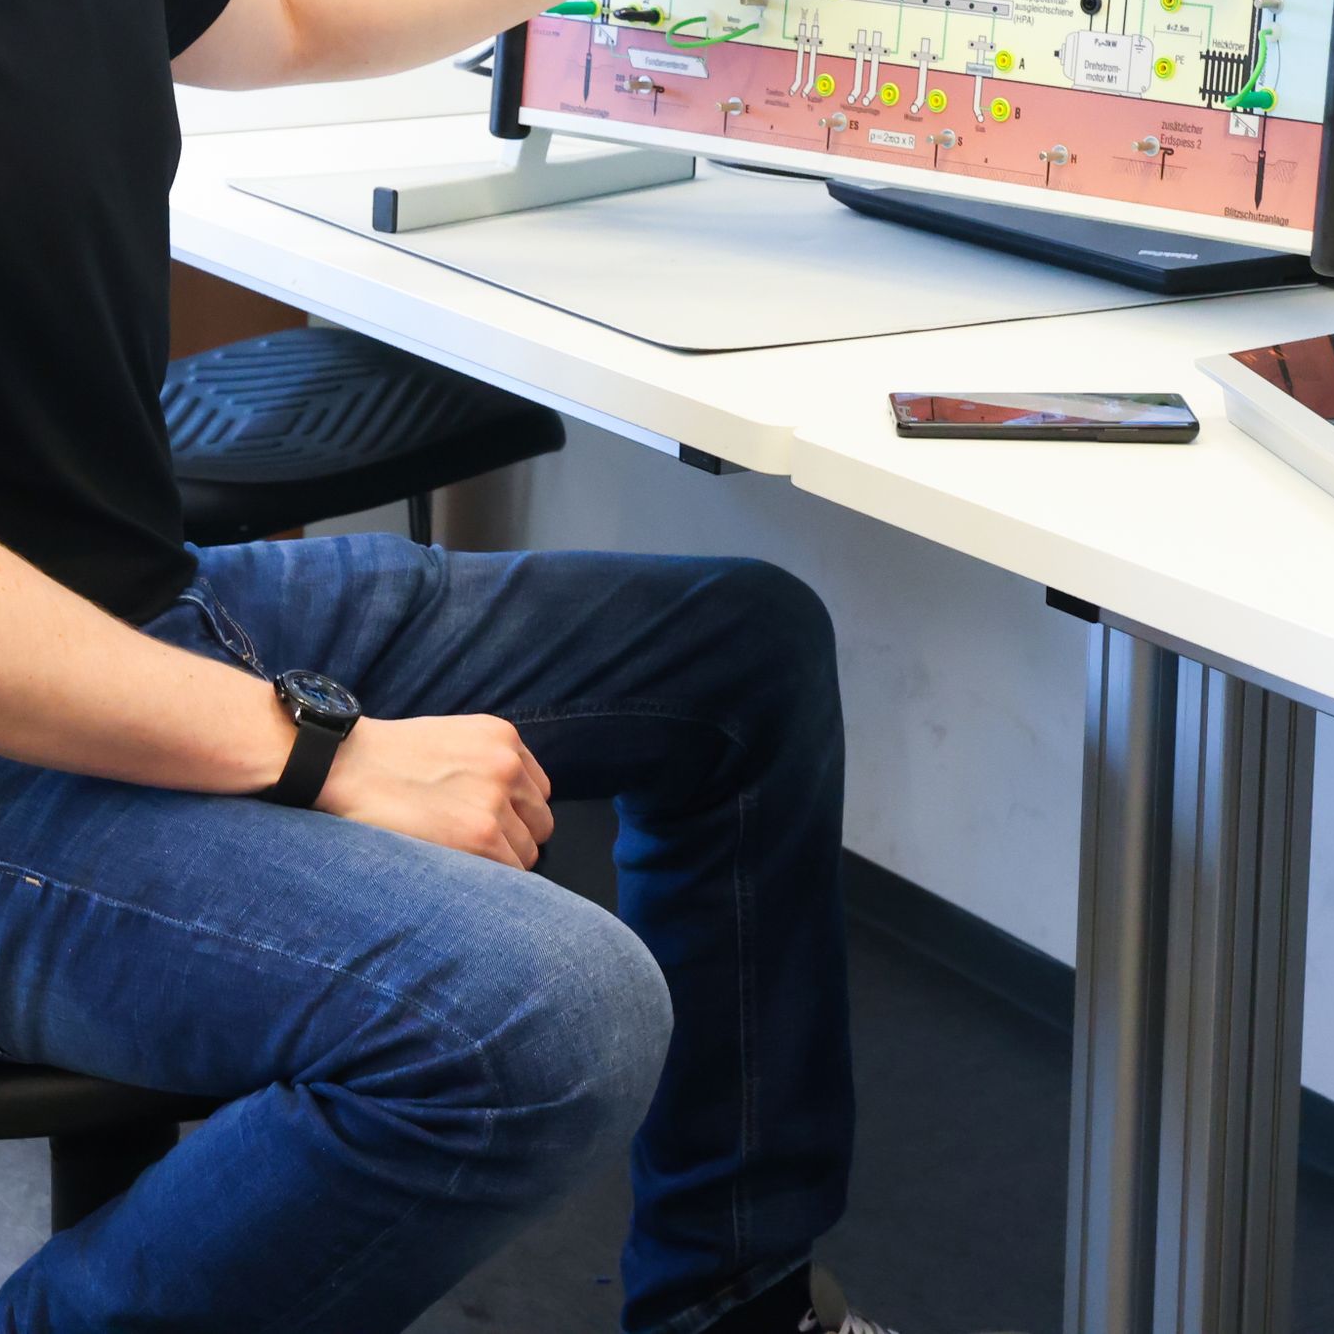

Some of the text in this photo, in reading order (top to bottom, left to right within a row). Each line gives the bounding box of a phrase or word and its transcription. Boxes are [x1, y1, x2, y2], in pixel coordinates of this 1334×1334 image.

[1014, 2, 1074, 19] ausgleichschiene
[1014, 14, 1035, 27] (HPA)
[1212, 37, 1245, 52] Heizkörper
[1018, 61, 1026, 70] A
[1084, 60, 1122, 74] Drehstrom-
[1085, 71, 1118, 84] motor M1
[1014, 107, 1022, 119] B
[849, 120, 860, 131] ES
[1161, 120, 1204, 136] zusätzlicher
[957, 135, 964, 147] S
[1160, 134, 1196, 149] Erdspiess
[1224, 206, 1291, 227] Blitzschutzanlage
